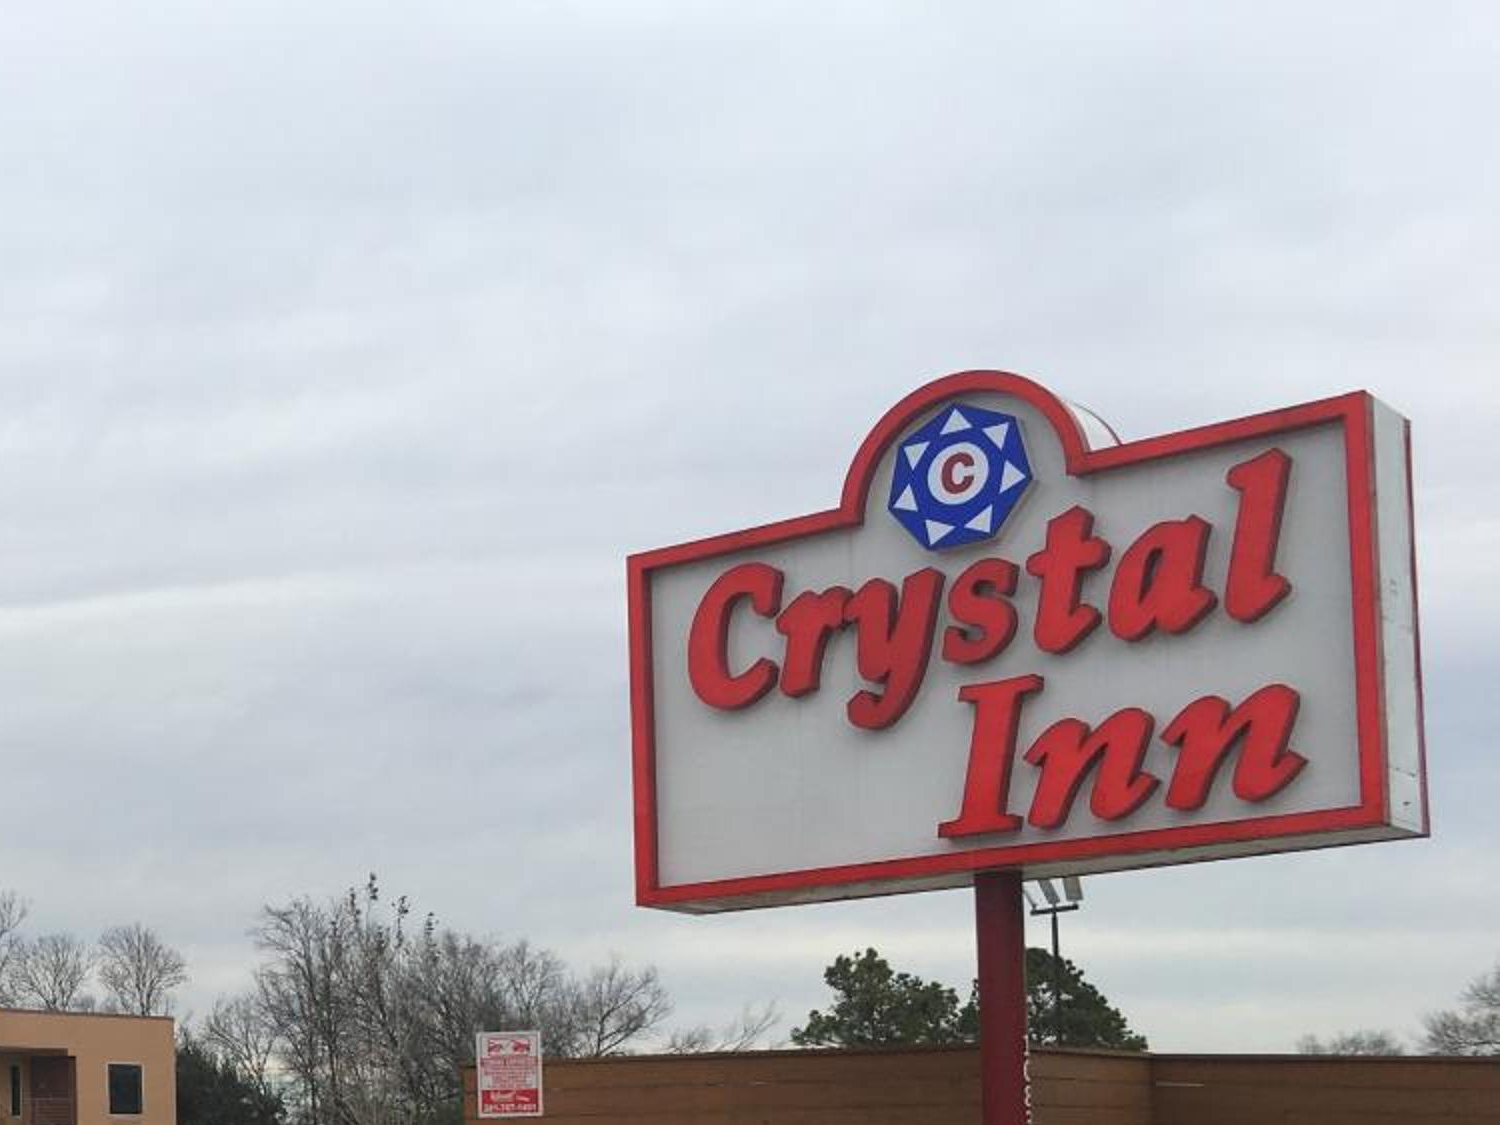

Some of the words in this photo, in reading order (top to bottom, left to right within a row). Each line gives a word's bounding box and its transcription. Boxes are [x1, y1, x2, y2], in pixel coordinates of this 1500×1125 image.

[940, 452, 975, 496] C
[687, 447, 1294, 731] Crystal
[937, 673, 1308, 839] Inn
